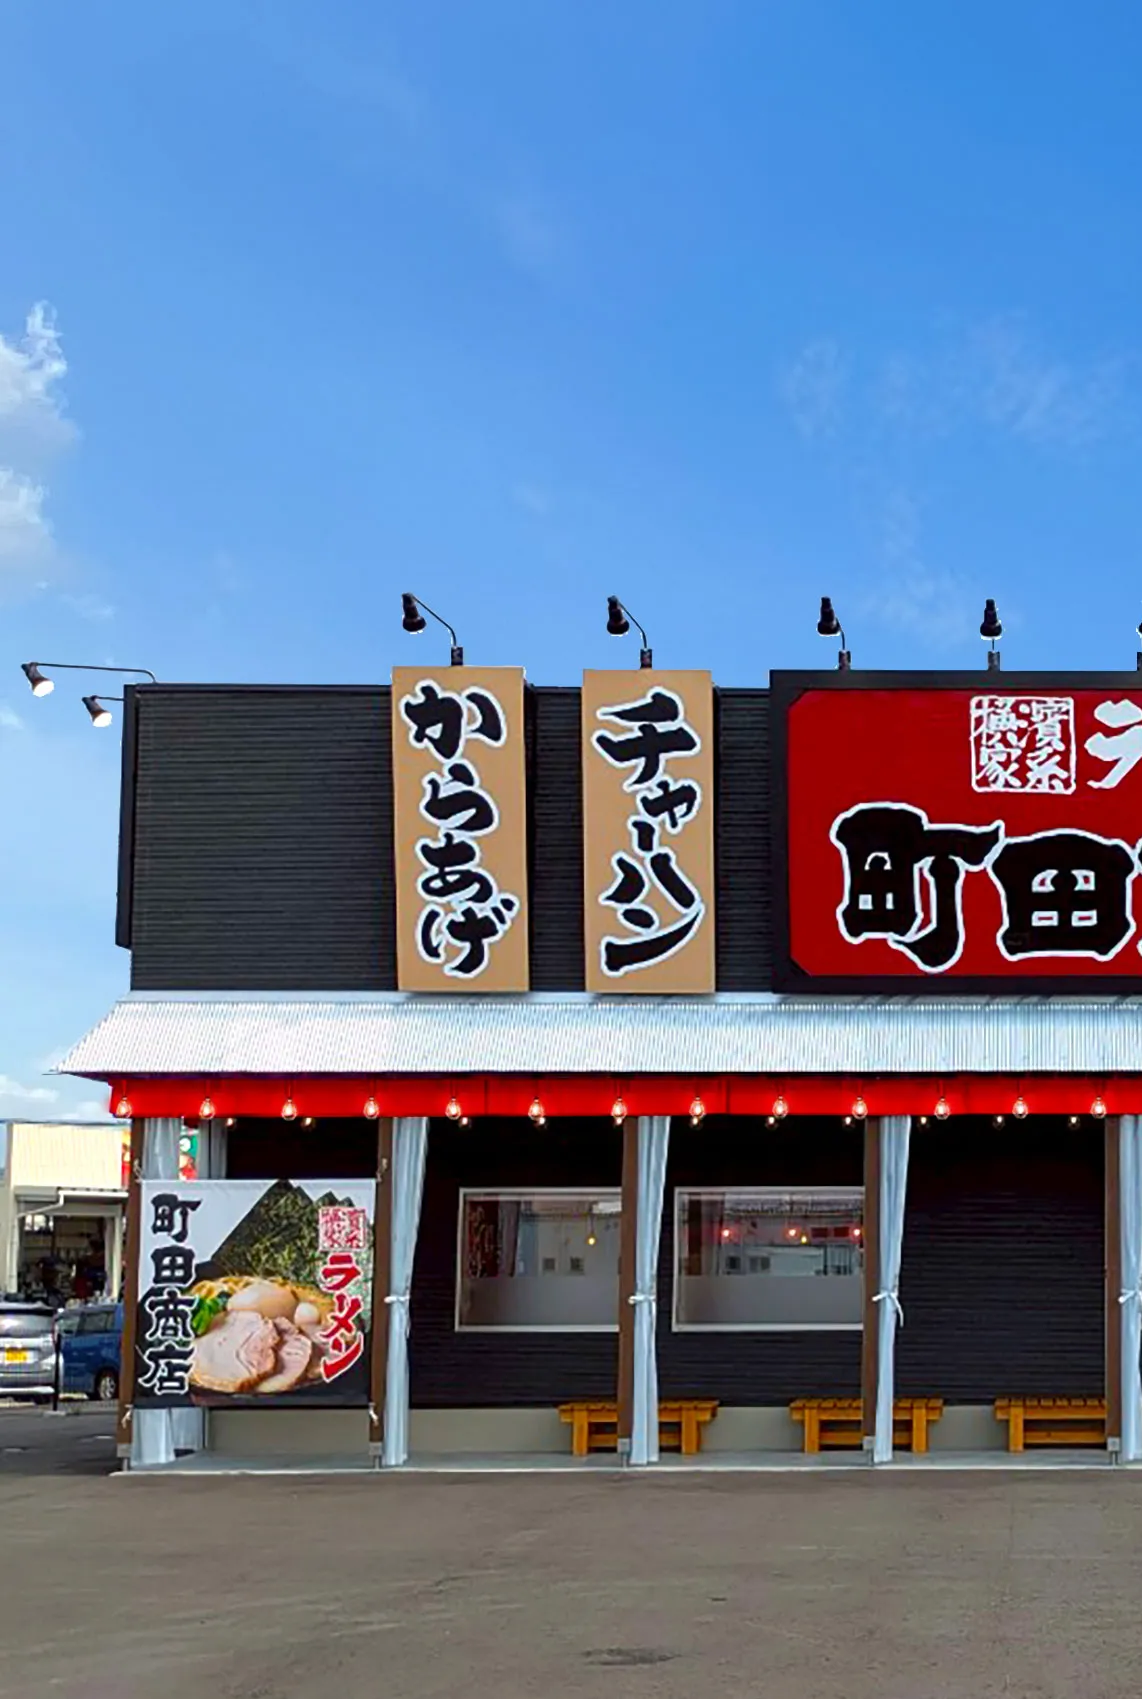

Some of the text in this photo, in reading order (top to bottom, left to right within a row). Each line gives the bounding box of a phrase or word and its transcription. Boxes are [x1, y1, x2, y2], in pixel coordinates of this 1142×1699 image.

[401, 679, 520, 978] からあげ
[591, 686, 705, 976] チャーハン
[138, 1193, 203, 1396] 町田商店
[319, 1252, 365, 1383] ラーメン
